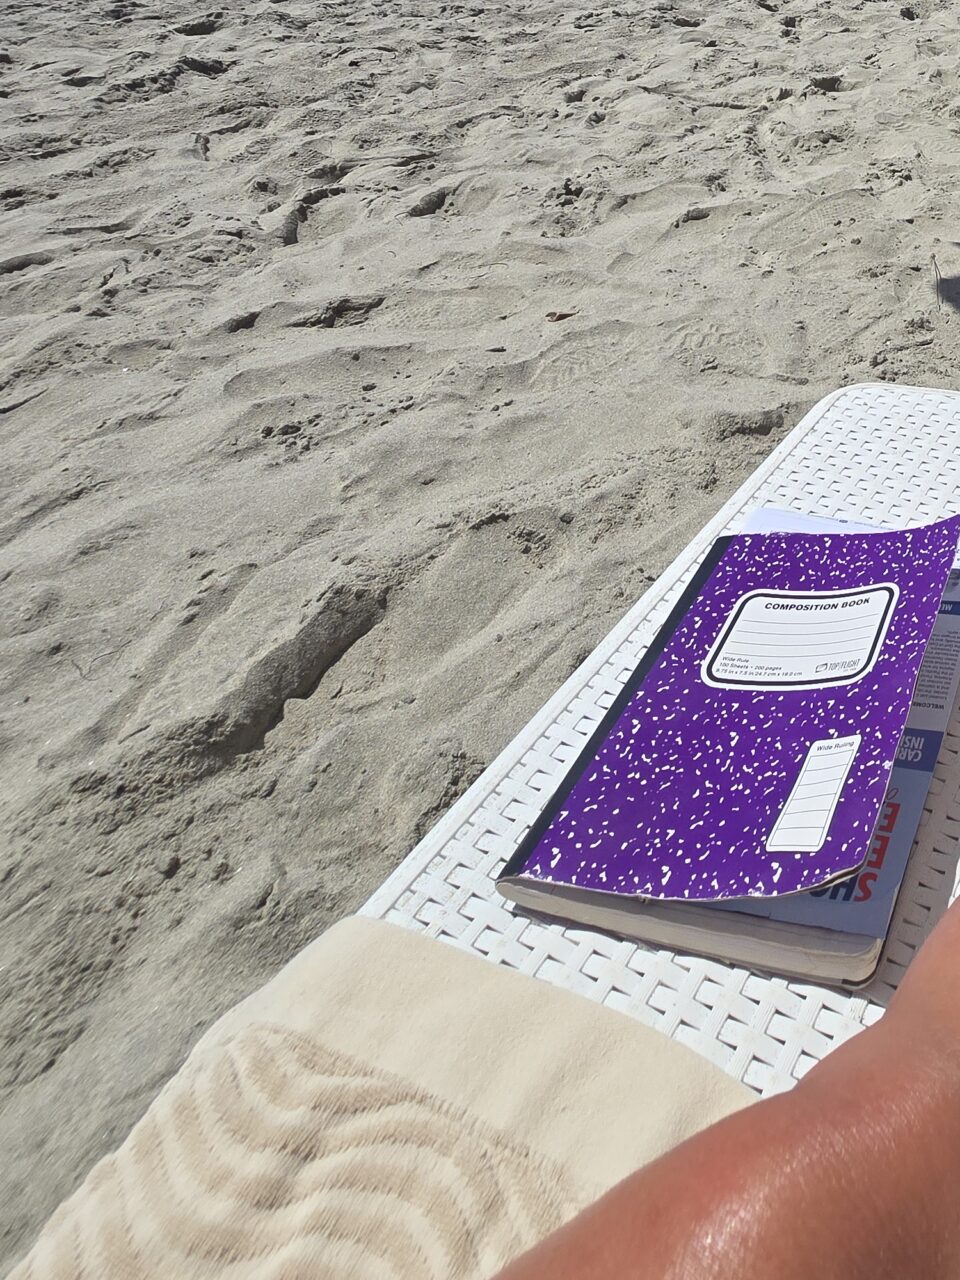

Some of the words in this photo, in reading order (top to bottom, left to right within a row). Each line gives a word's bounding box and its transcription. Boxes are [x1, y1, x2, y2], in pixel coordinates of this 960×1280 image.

[764, 602, 839, 611] COMPOSITION
[841, 597, 870, 609] BOOK
[834, 741, 855, 749] Ruling
